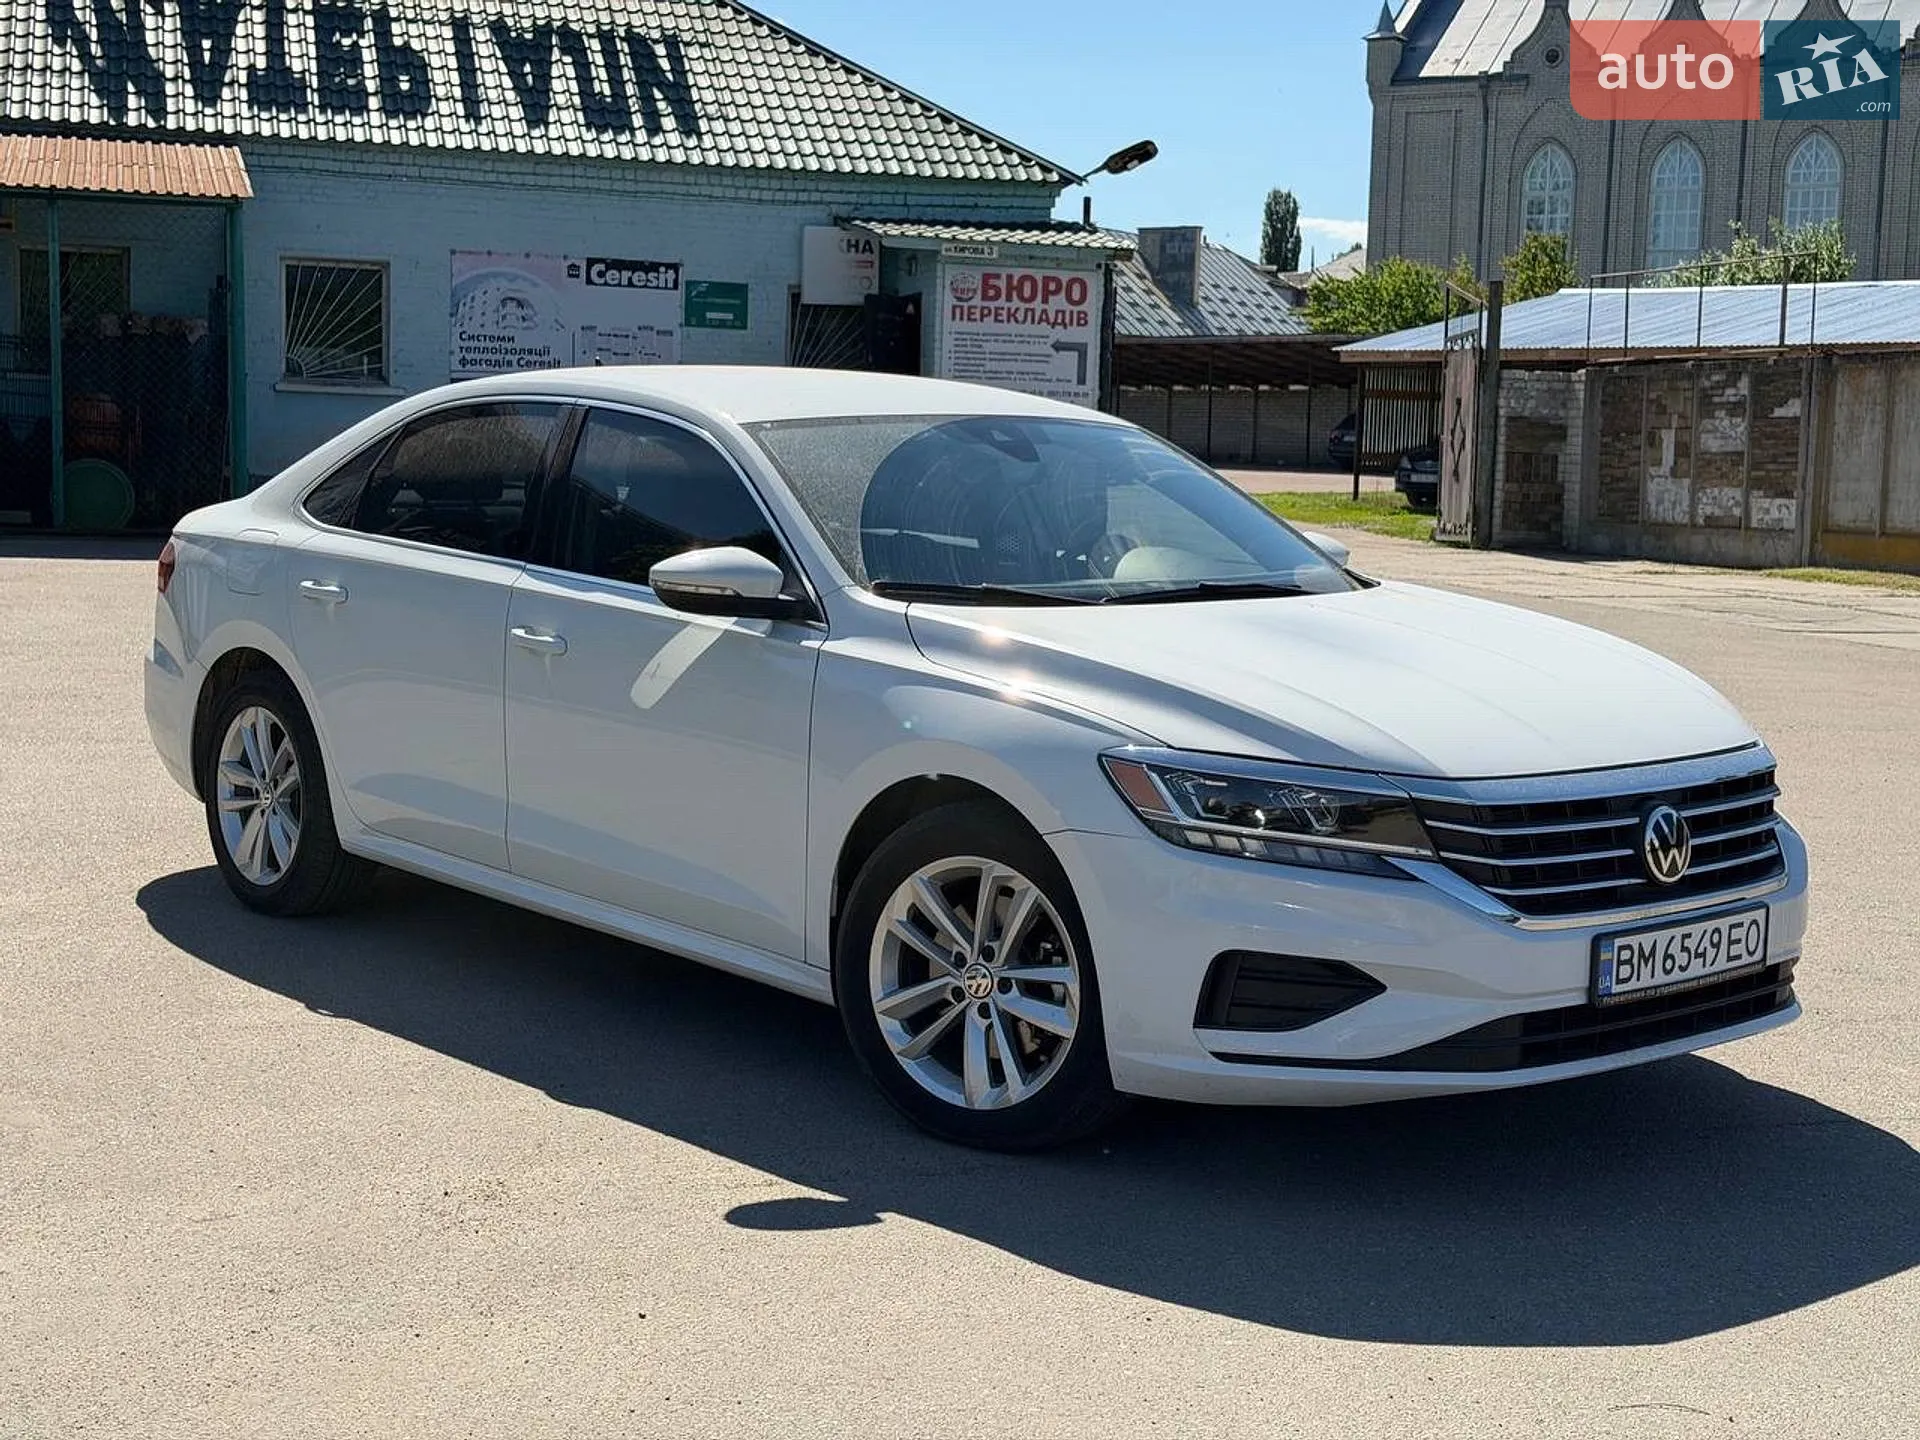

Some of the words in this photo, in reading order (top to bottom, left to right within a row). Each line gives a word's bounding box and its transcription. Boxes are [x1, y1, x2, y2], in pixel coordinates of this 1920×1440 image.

[590, 263, 676, 289] Ceresit
[980, 271, 1088, 307] БЮРО
[951, 304, 1089, 330] ПЕРЕКЛАДІВ
[459, 330, 516, 344] Системи
[459, 355, 514, 369] фасадів
[517, 357, 562, 369] Ceresit
